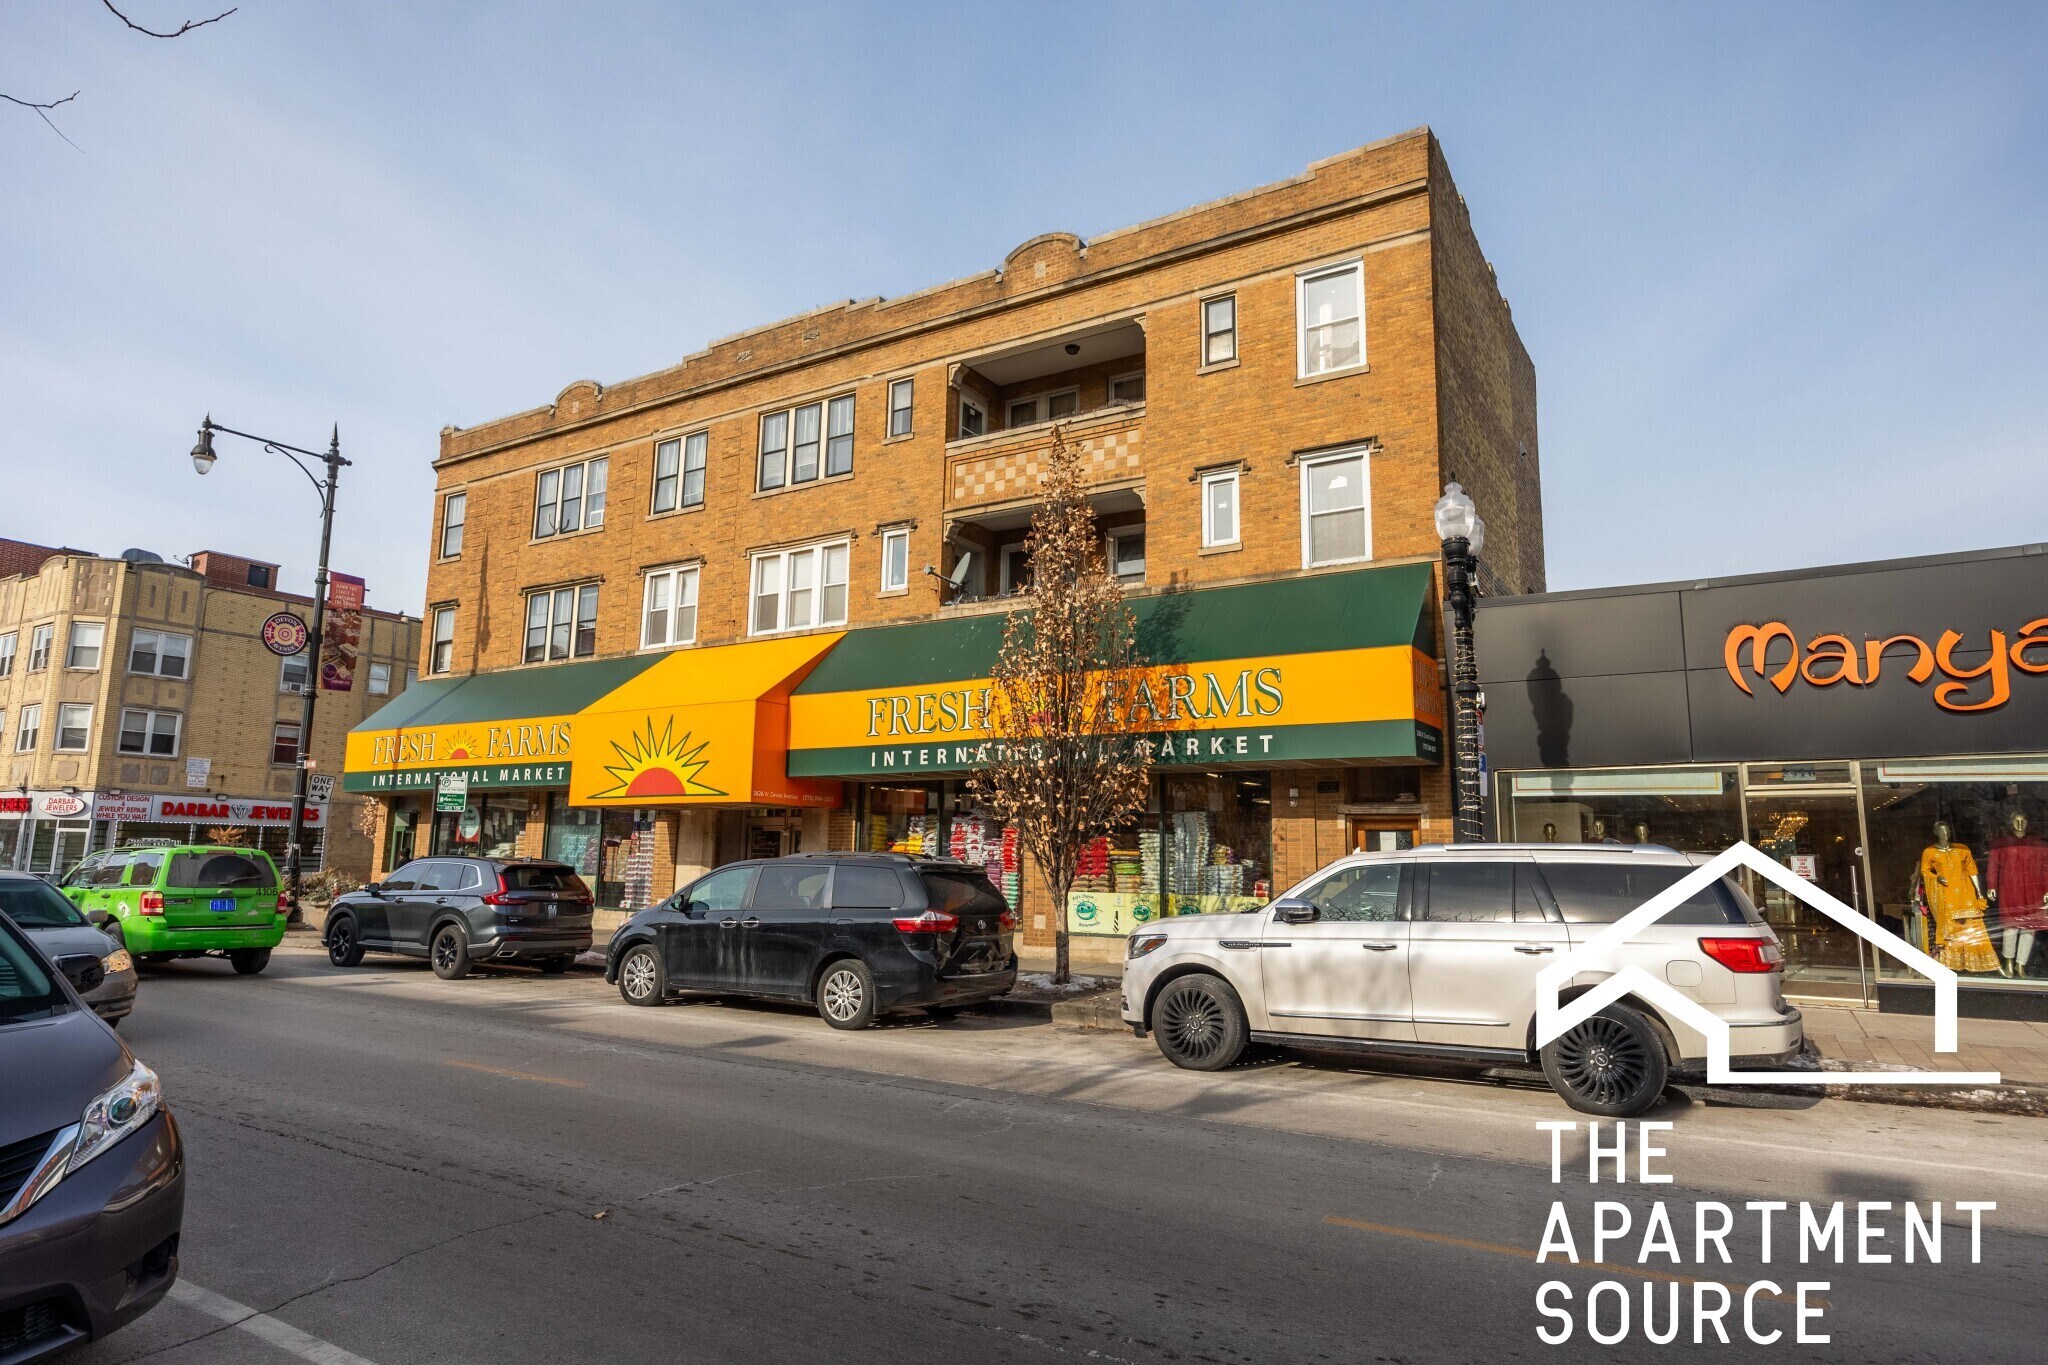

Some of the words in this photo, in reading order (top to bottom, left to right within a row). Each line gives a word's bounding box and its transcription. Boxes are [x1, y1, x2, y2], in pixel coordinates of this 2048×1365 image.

[275, 616, 298, 627] DEVON
[273, 642, 297, 652] AVENUE
[867, 687, 994, 738] FRESH
[1103, 667, 1283, 725] FARMS
[372, 732, 438, 765] FRESH
[486, 722, 572, 759] FARMS
[871, 741, 1108, 768] INTERNATIOL
[313, 776, 333, 786] ONE
[372, 770, 490, 787] INTERNANAL
[499, 767, 565, 781] MARKET
[311, 784, 331, 793] WAY
[48, 797, 76, 805] DARBAR
[45, 804, 78, 812] JEWELERS
[161, 801, 230, 818] DARBAR
[248, 805, 320, 822] JEWERS
